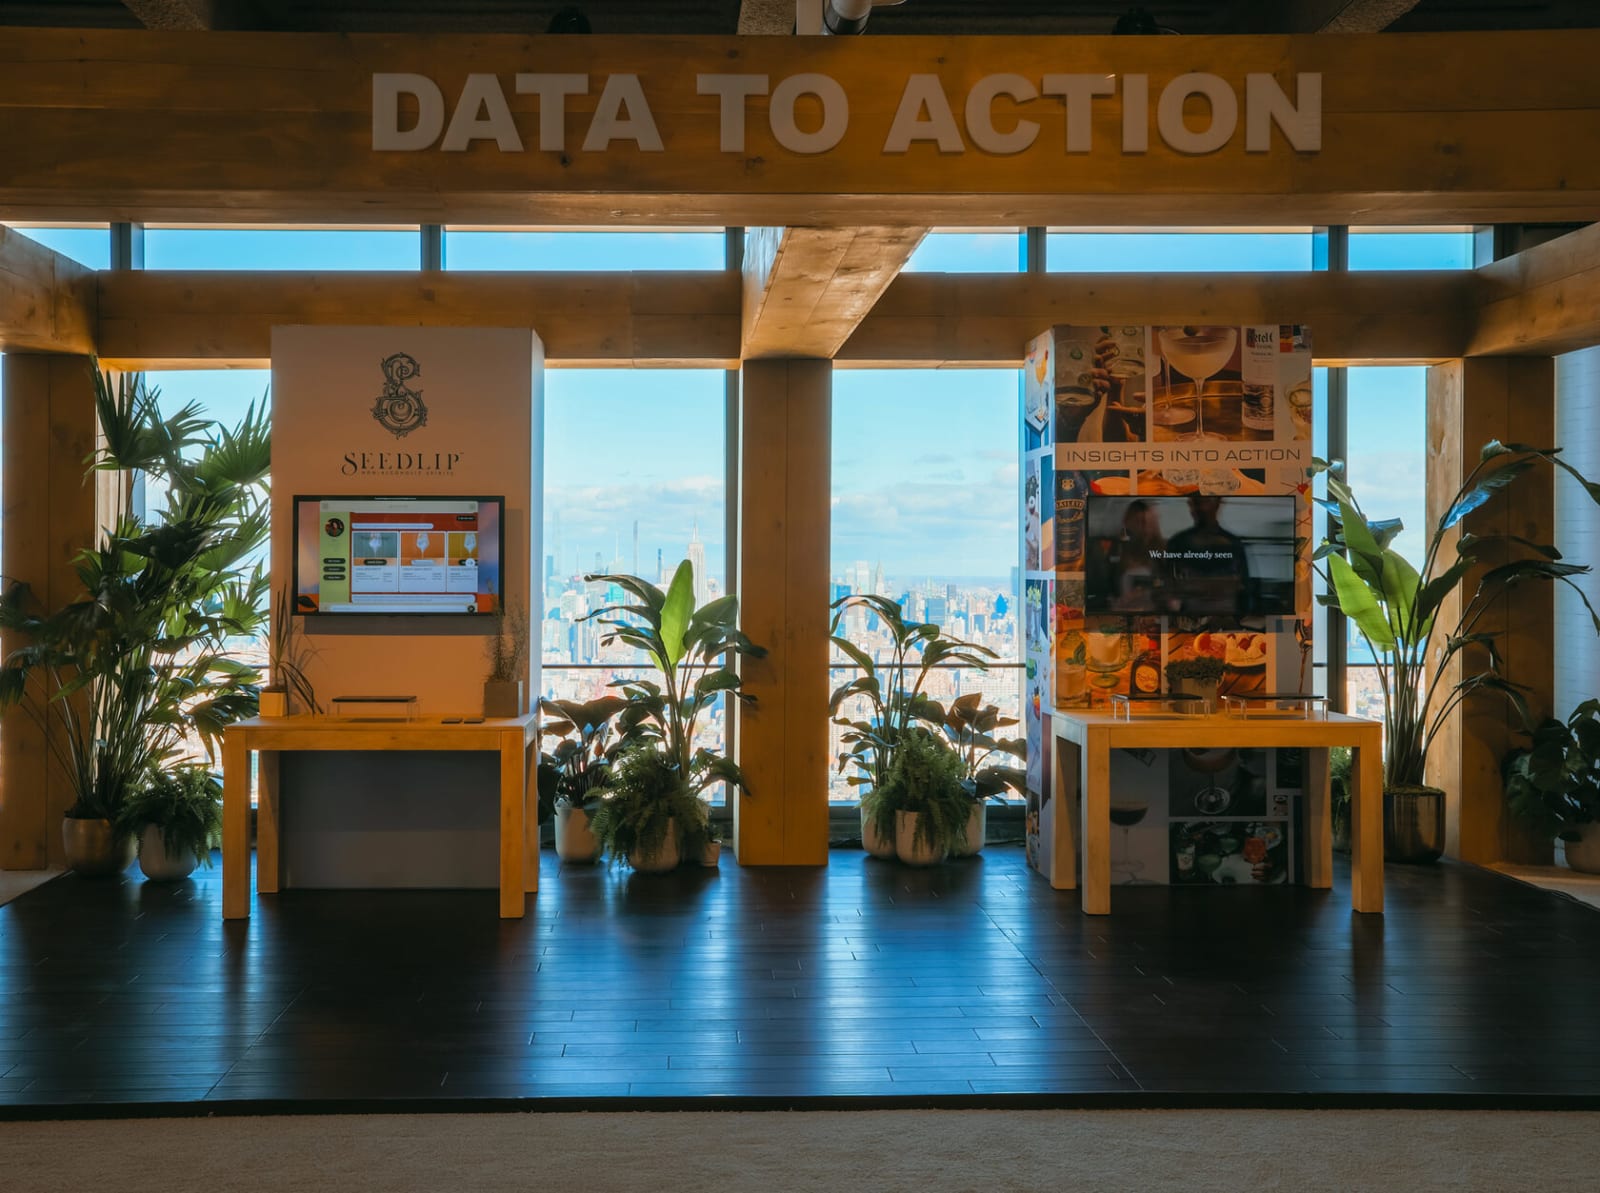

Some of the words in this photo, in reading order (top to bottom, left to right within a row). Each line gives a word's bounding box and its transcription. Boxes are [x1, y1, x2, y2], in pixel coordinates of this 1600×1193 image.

[372, 73, 664, 152] DATA
[697, 73, 849, 153] TO
[883, 72, 1322, 154] ACTION
[341, 452, 460, 475] SEEDLIP
[1067, 450, 1164, 463] INSIGHTS
[1170, 450, 1219, 462] INTO
[1225, 448, 1300, 462] ACTION
[1149, 550, 1162, 559] We
[1163, 550, 1182, 559] have
[1183, 550, 1213, 560] already
